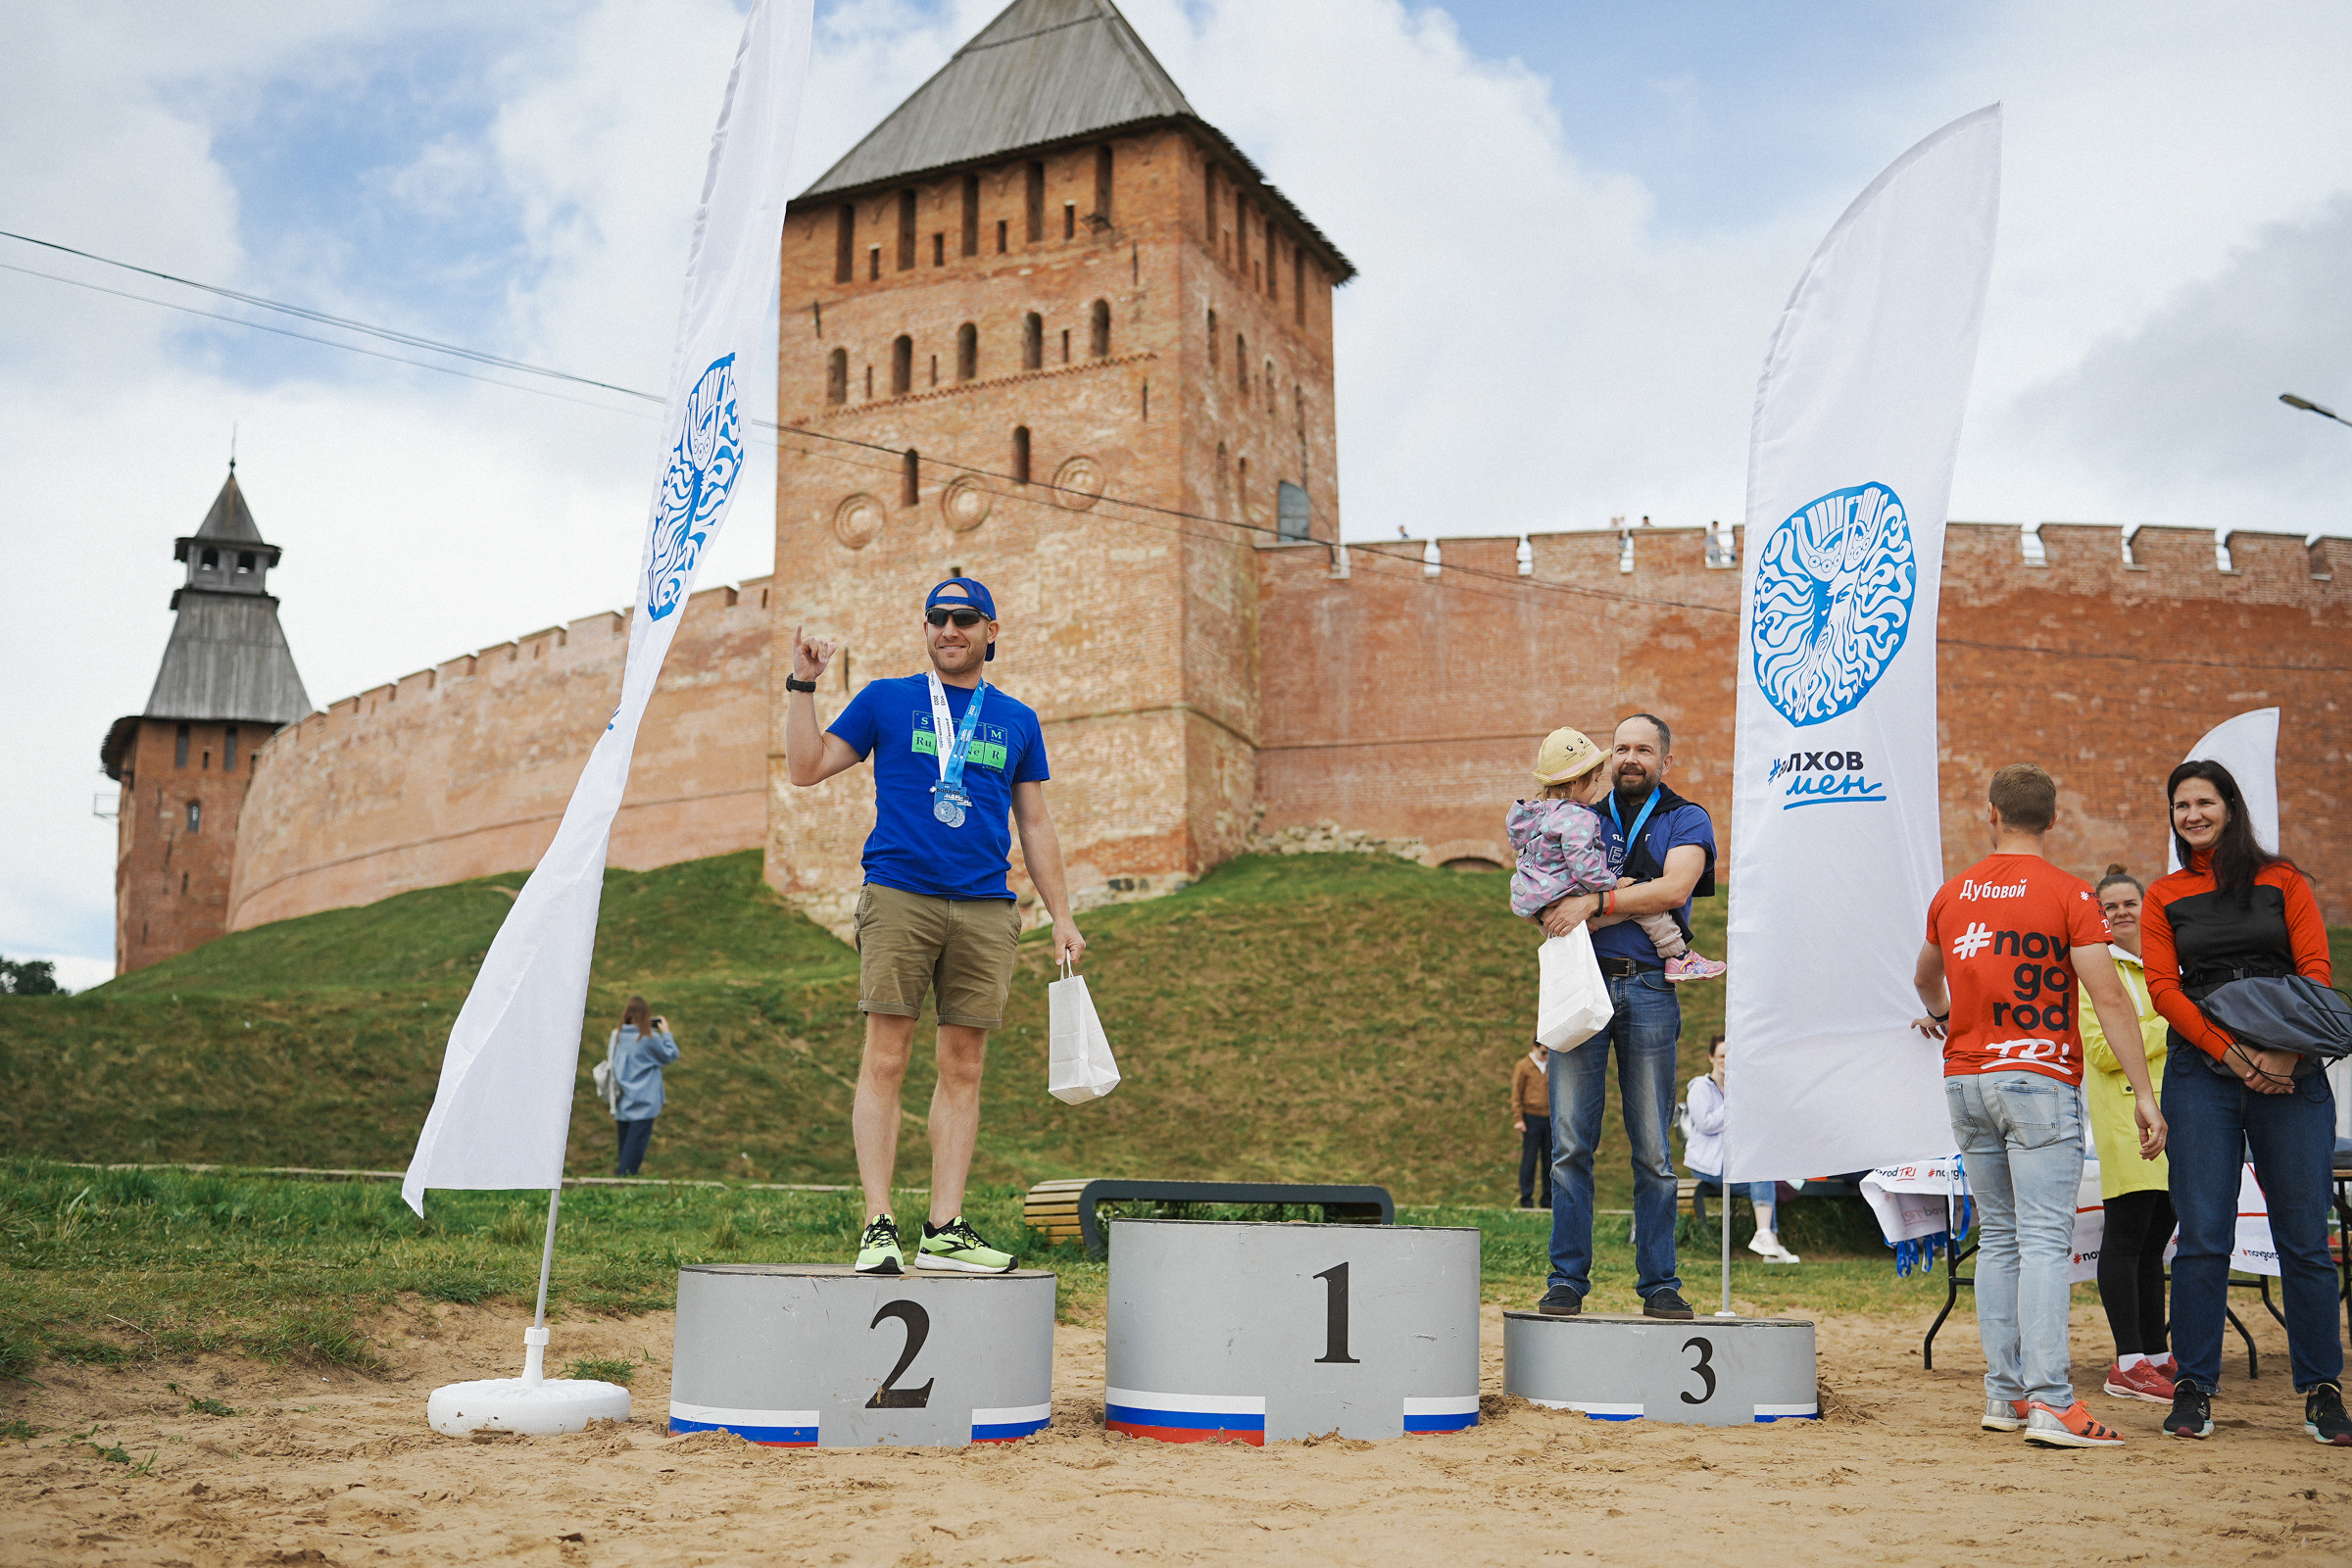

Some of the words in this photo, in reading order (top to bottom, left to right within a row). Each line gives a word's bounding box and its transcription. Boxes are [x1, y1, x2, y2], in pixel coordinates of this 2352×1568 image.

[916, 736, 932, 747] Ru
[992, 750, 1000, 760] R
[1786, 774, 1883, 796] мен
[1959, 878, 2028, 902] Дубовой
[1952, 921, 2071, 962] #nov
[2013, 962, 2070, 1002] go
[1992, 992, 2070, 1032] rod
[1312, 1261, 1360, 1363] 1
[865, 1299, 935, 1408] 2
[1680, 1337, 1716, 1404] 3
